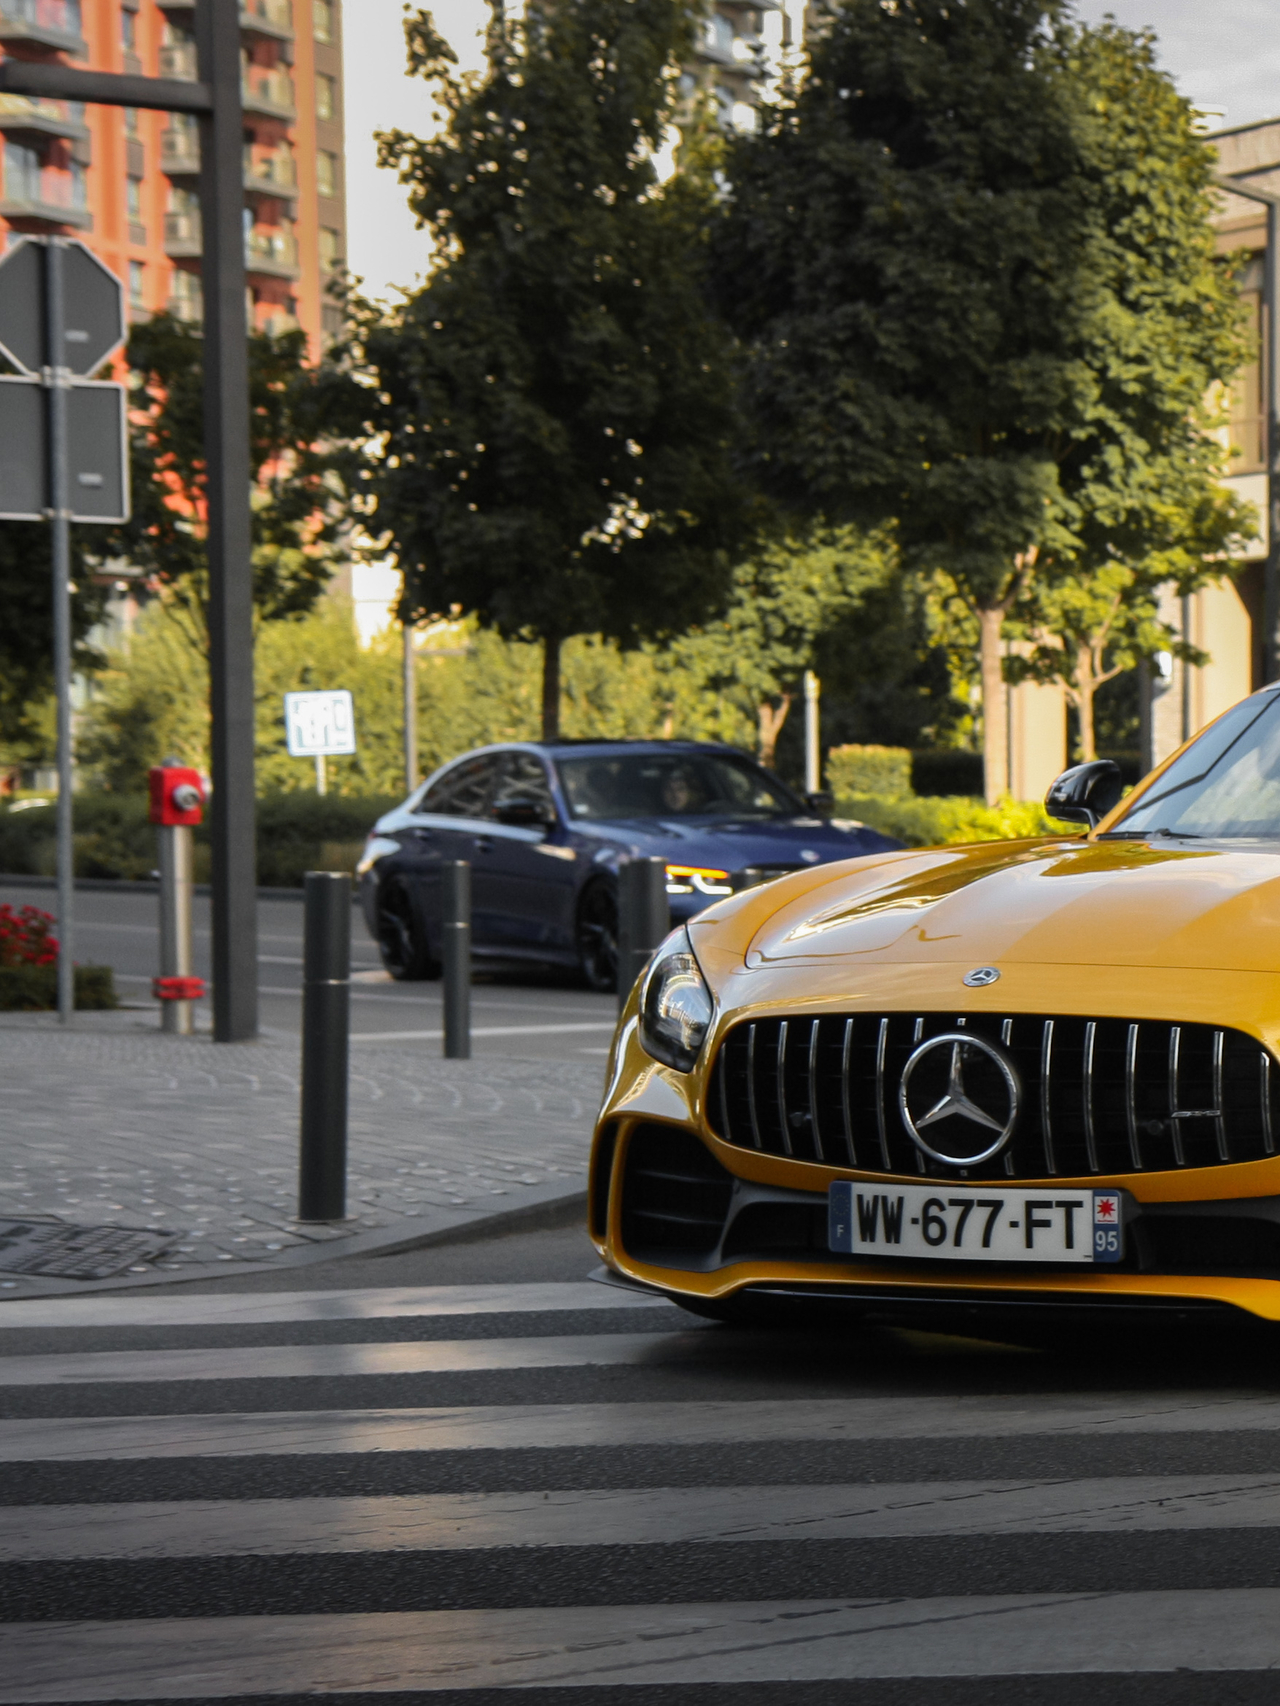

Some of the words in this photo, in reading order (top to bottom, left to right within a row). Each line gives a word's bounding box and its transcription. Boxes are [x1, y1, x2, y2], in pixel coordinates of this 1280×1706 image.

[836, 1224, 845, 1237] F
[857, 1193, 1083, 1249] WW-677-FT
[1095, 1230, 1118, 1251] 95
